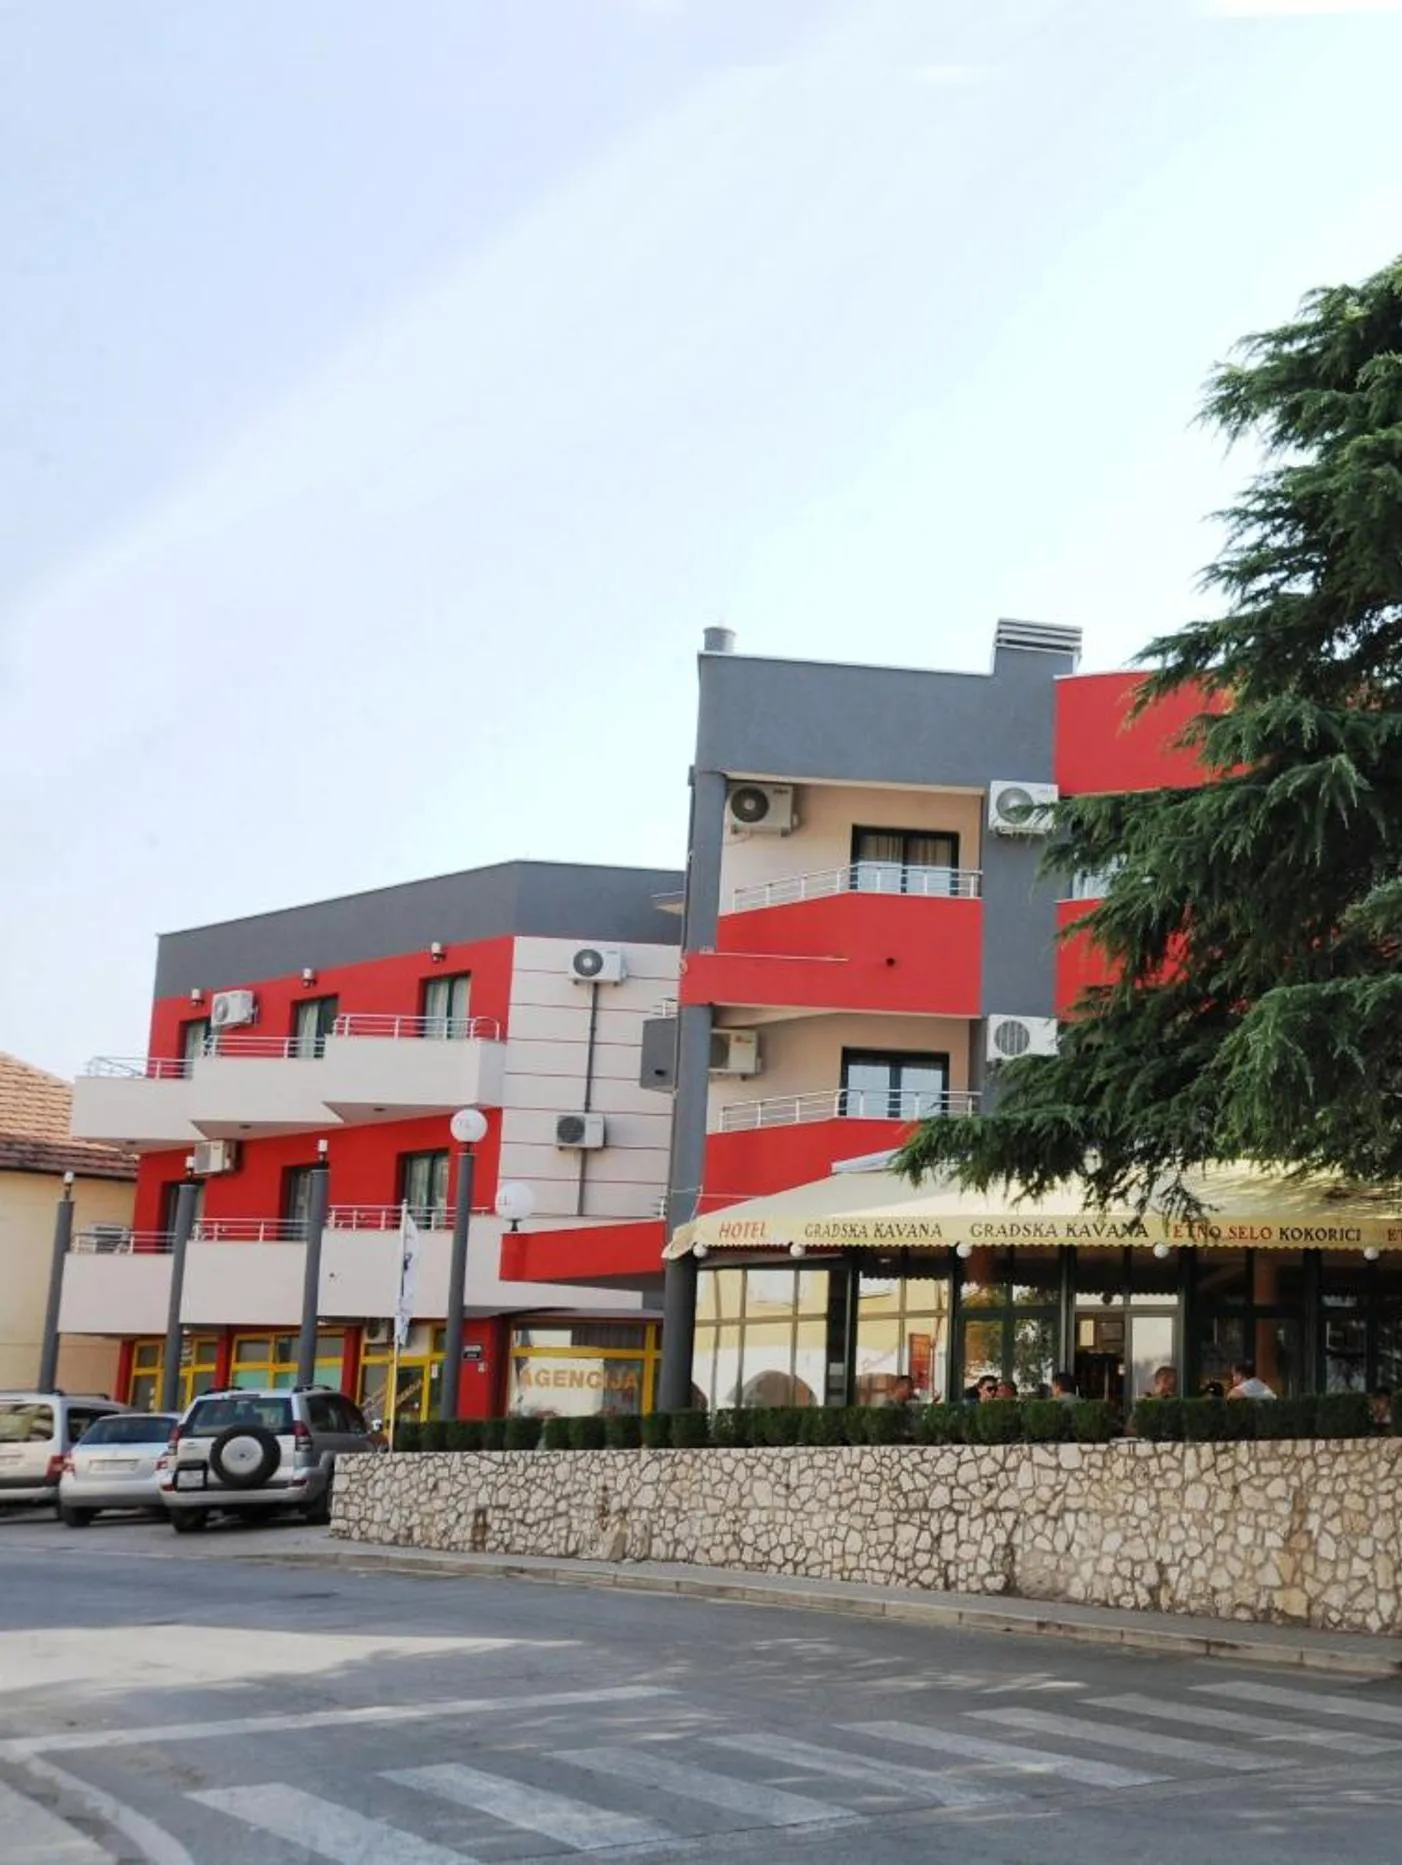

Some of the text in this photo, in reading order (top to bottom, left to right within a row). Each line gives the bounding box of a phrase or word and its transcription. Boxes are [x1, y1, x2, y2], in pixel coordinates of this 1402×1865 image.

[718, 1221, 767, 1239] HOTEL
[804, 1222, 943, 1239] GRADSKA KAVANA
[968, 1222, 1149, 1239] GRADSKA KAVANA
[1172, 1223, 1222, 1240] ETNO
[1227, 1225, 1273, 1241] SELO
[518, 1367, 639, 1391] AGENCIJA
